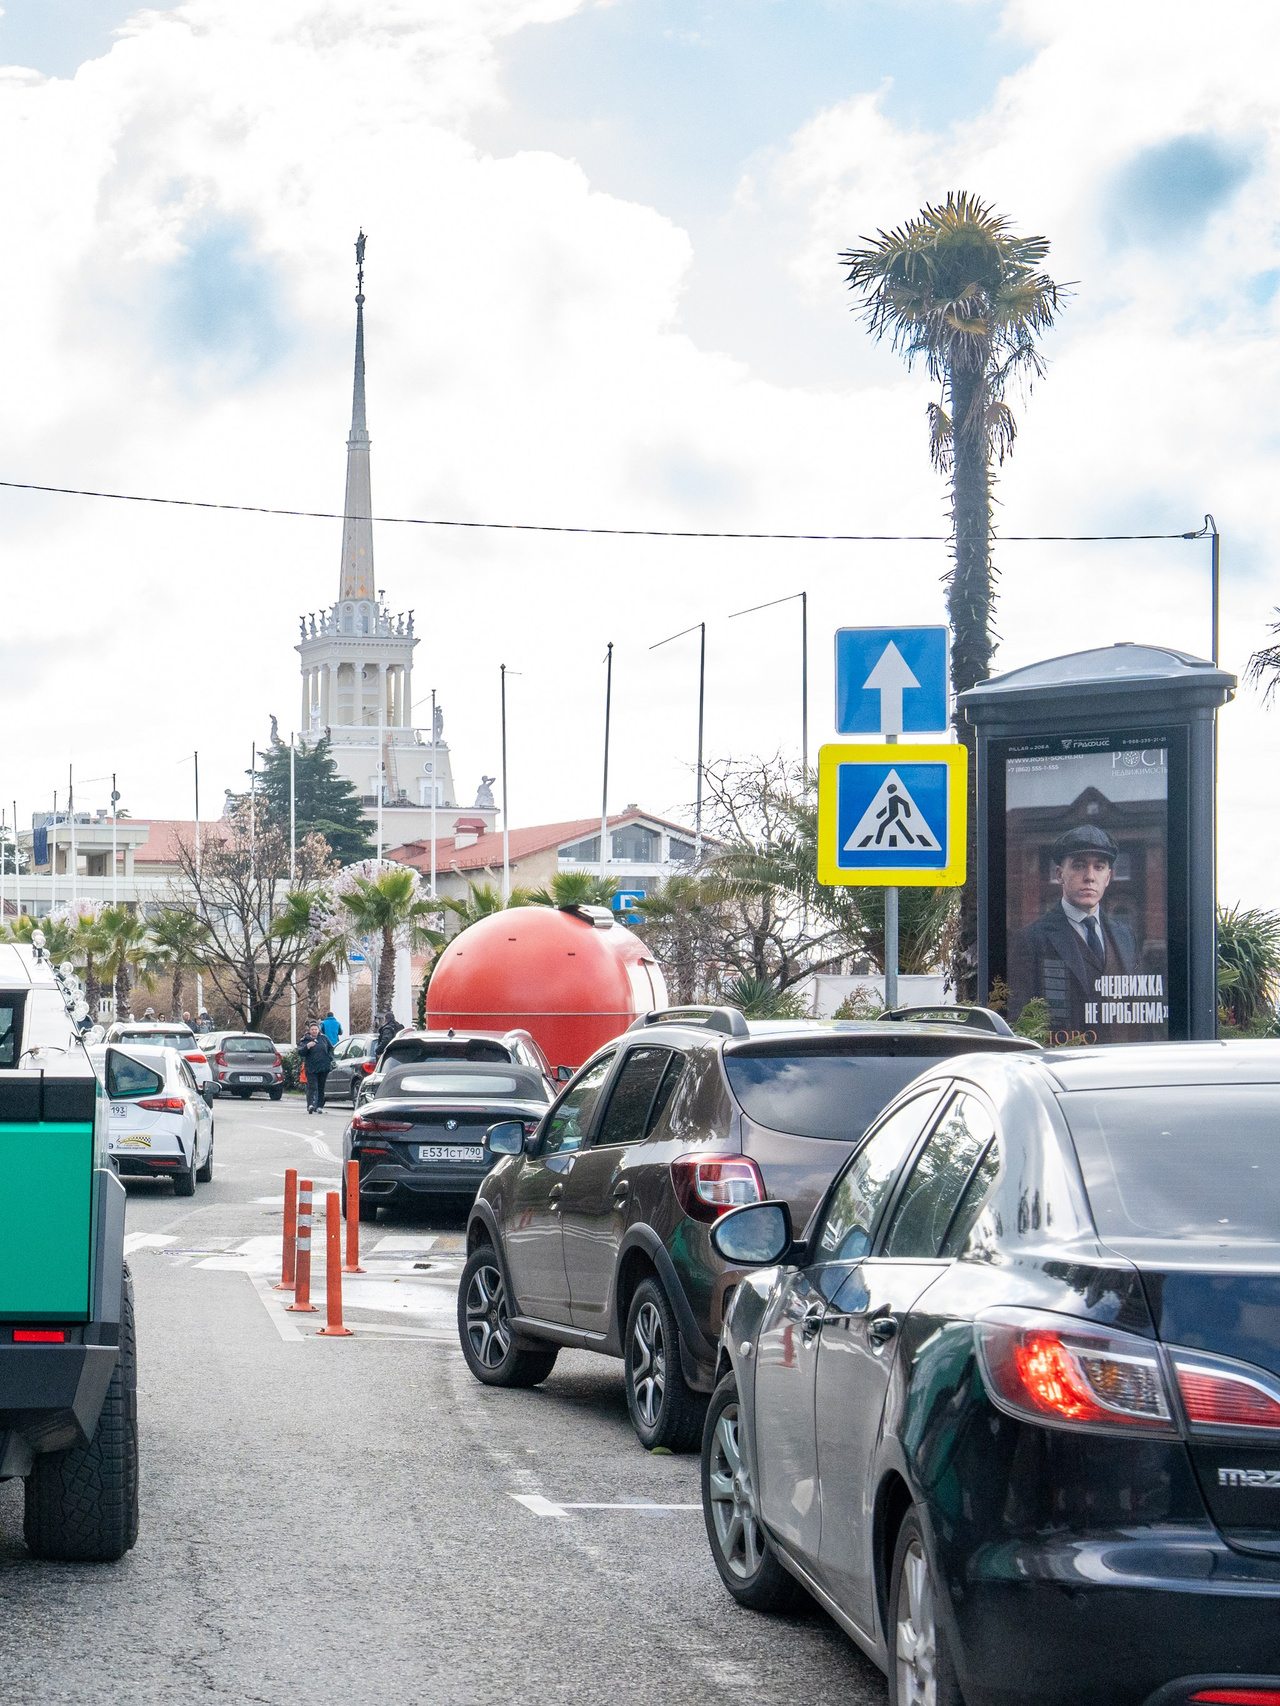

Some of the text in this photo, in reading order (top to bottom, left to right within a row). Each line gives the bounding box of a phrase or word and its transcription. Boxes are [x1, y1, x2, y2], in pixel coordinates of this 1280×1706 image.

[1094, 974, 1163, 999] «НЕДВИЖКА
[1084, 1002, 1169, 1024] НЕ ПРОБЛЕМА»
[110, 1106, 126, 1114] 193
[422, 1147, 481, 1158] Е531СТ 790
